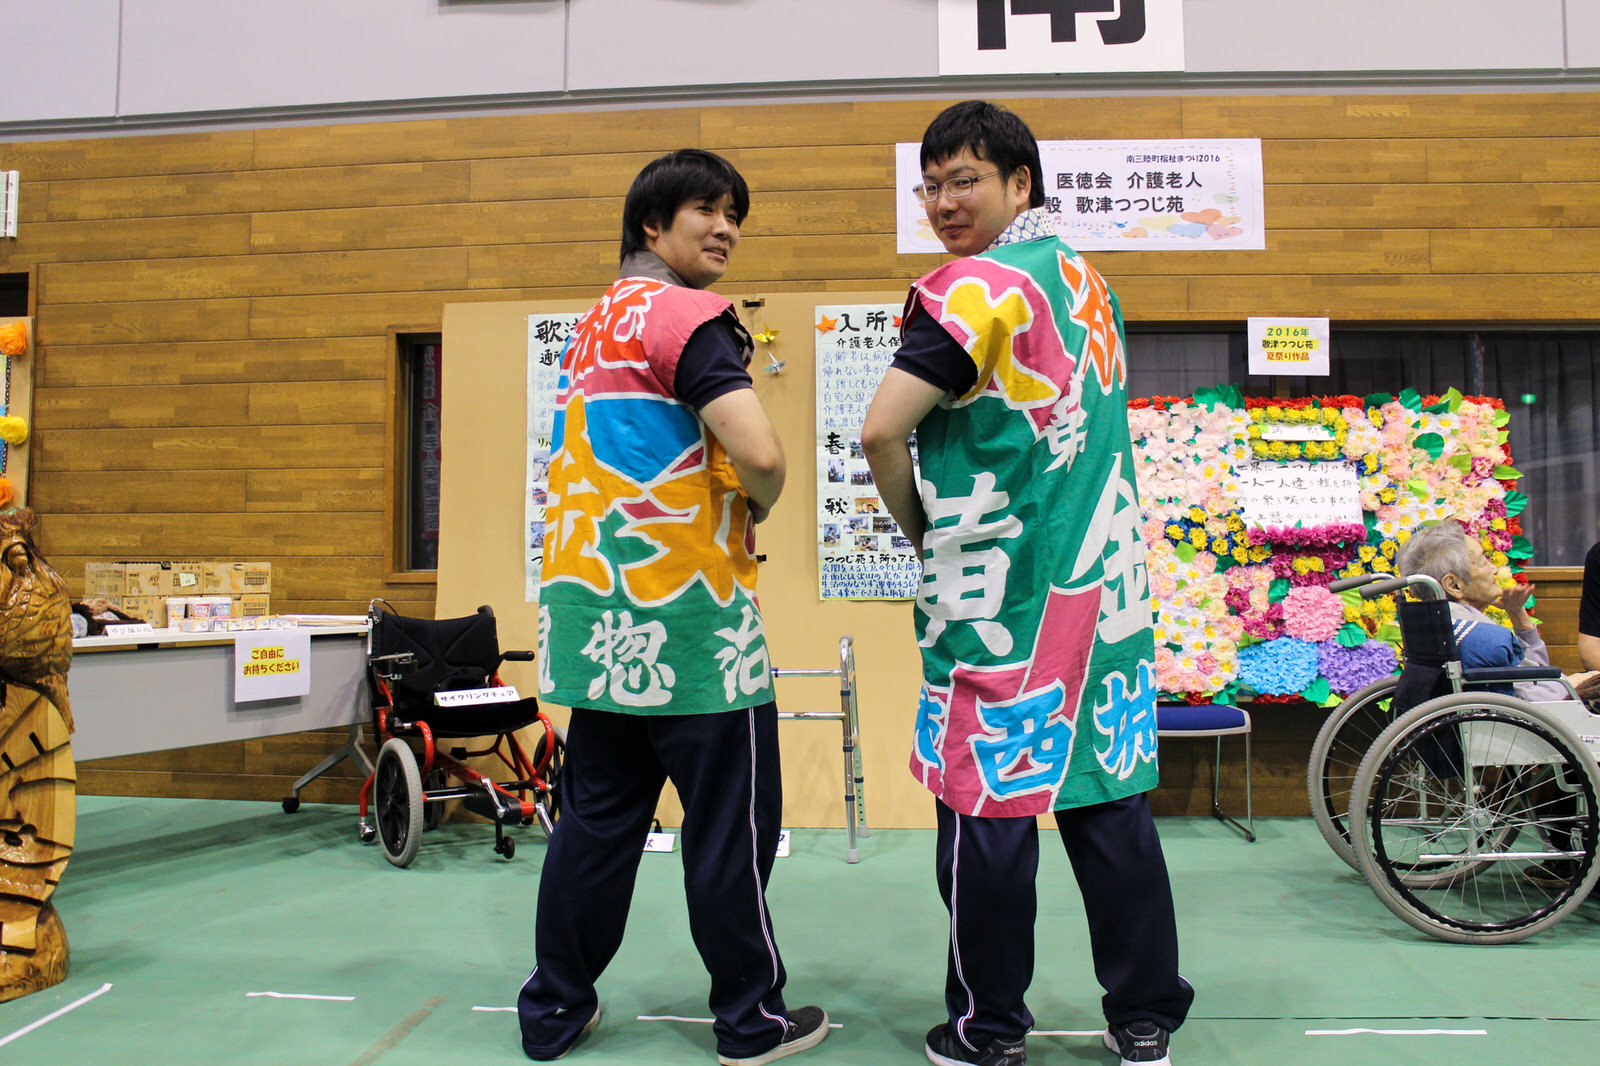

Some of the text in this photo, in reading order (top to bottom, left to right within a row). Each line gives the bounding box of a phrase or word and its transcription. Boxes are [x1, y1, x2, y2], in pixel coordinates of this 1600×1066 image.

[1126, 154, 1221, 163] 南三陸町福祉まつり2016
[1057, 172, 1203, 190] 医徳会 介護老人
[1076, 196, 1185, 214] 歌津つつじ苑
[839, 311, 888, 333] 入所
[1267, 327, 1309, 337] 2016年
[1262, 340, 1314, 349] 歌津つつじ苑
[825, 432, 846, 455] 春
[824, 497, 848, 515] 秋
[252, 648, 284, 660] ご自由に
[243, 661, 300, 675] お持ちください
